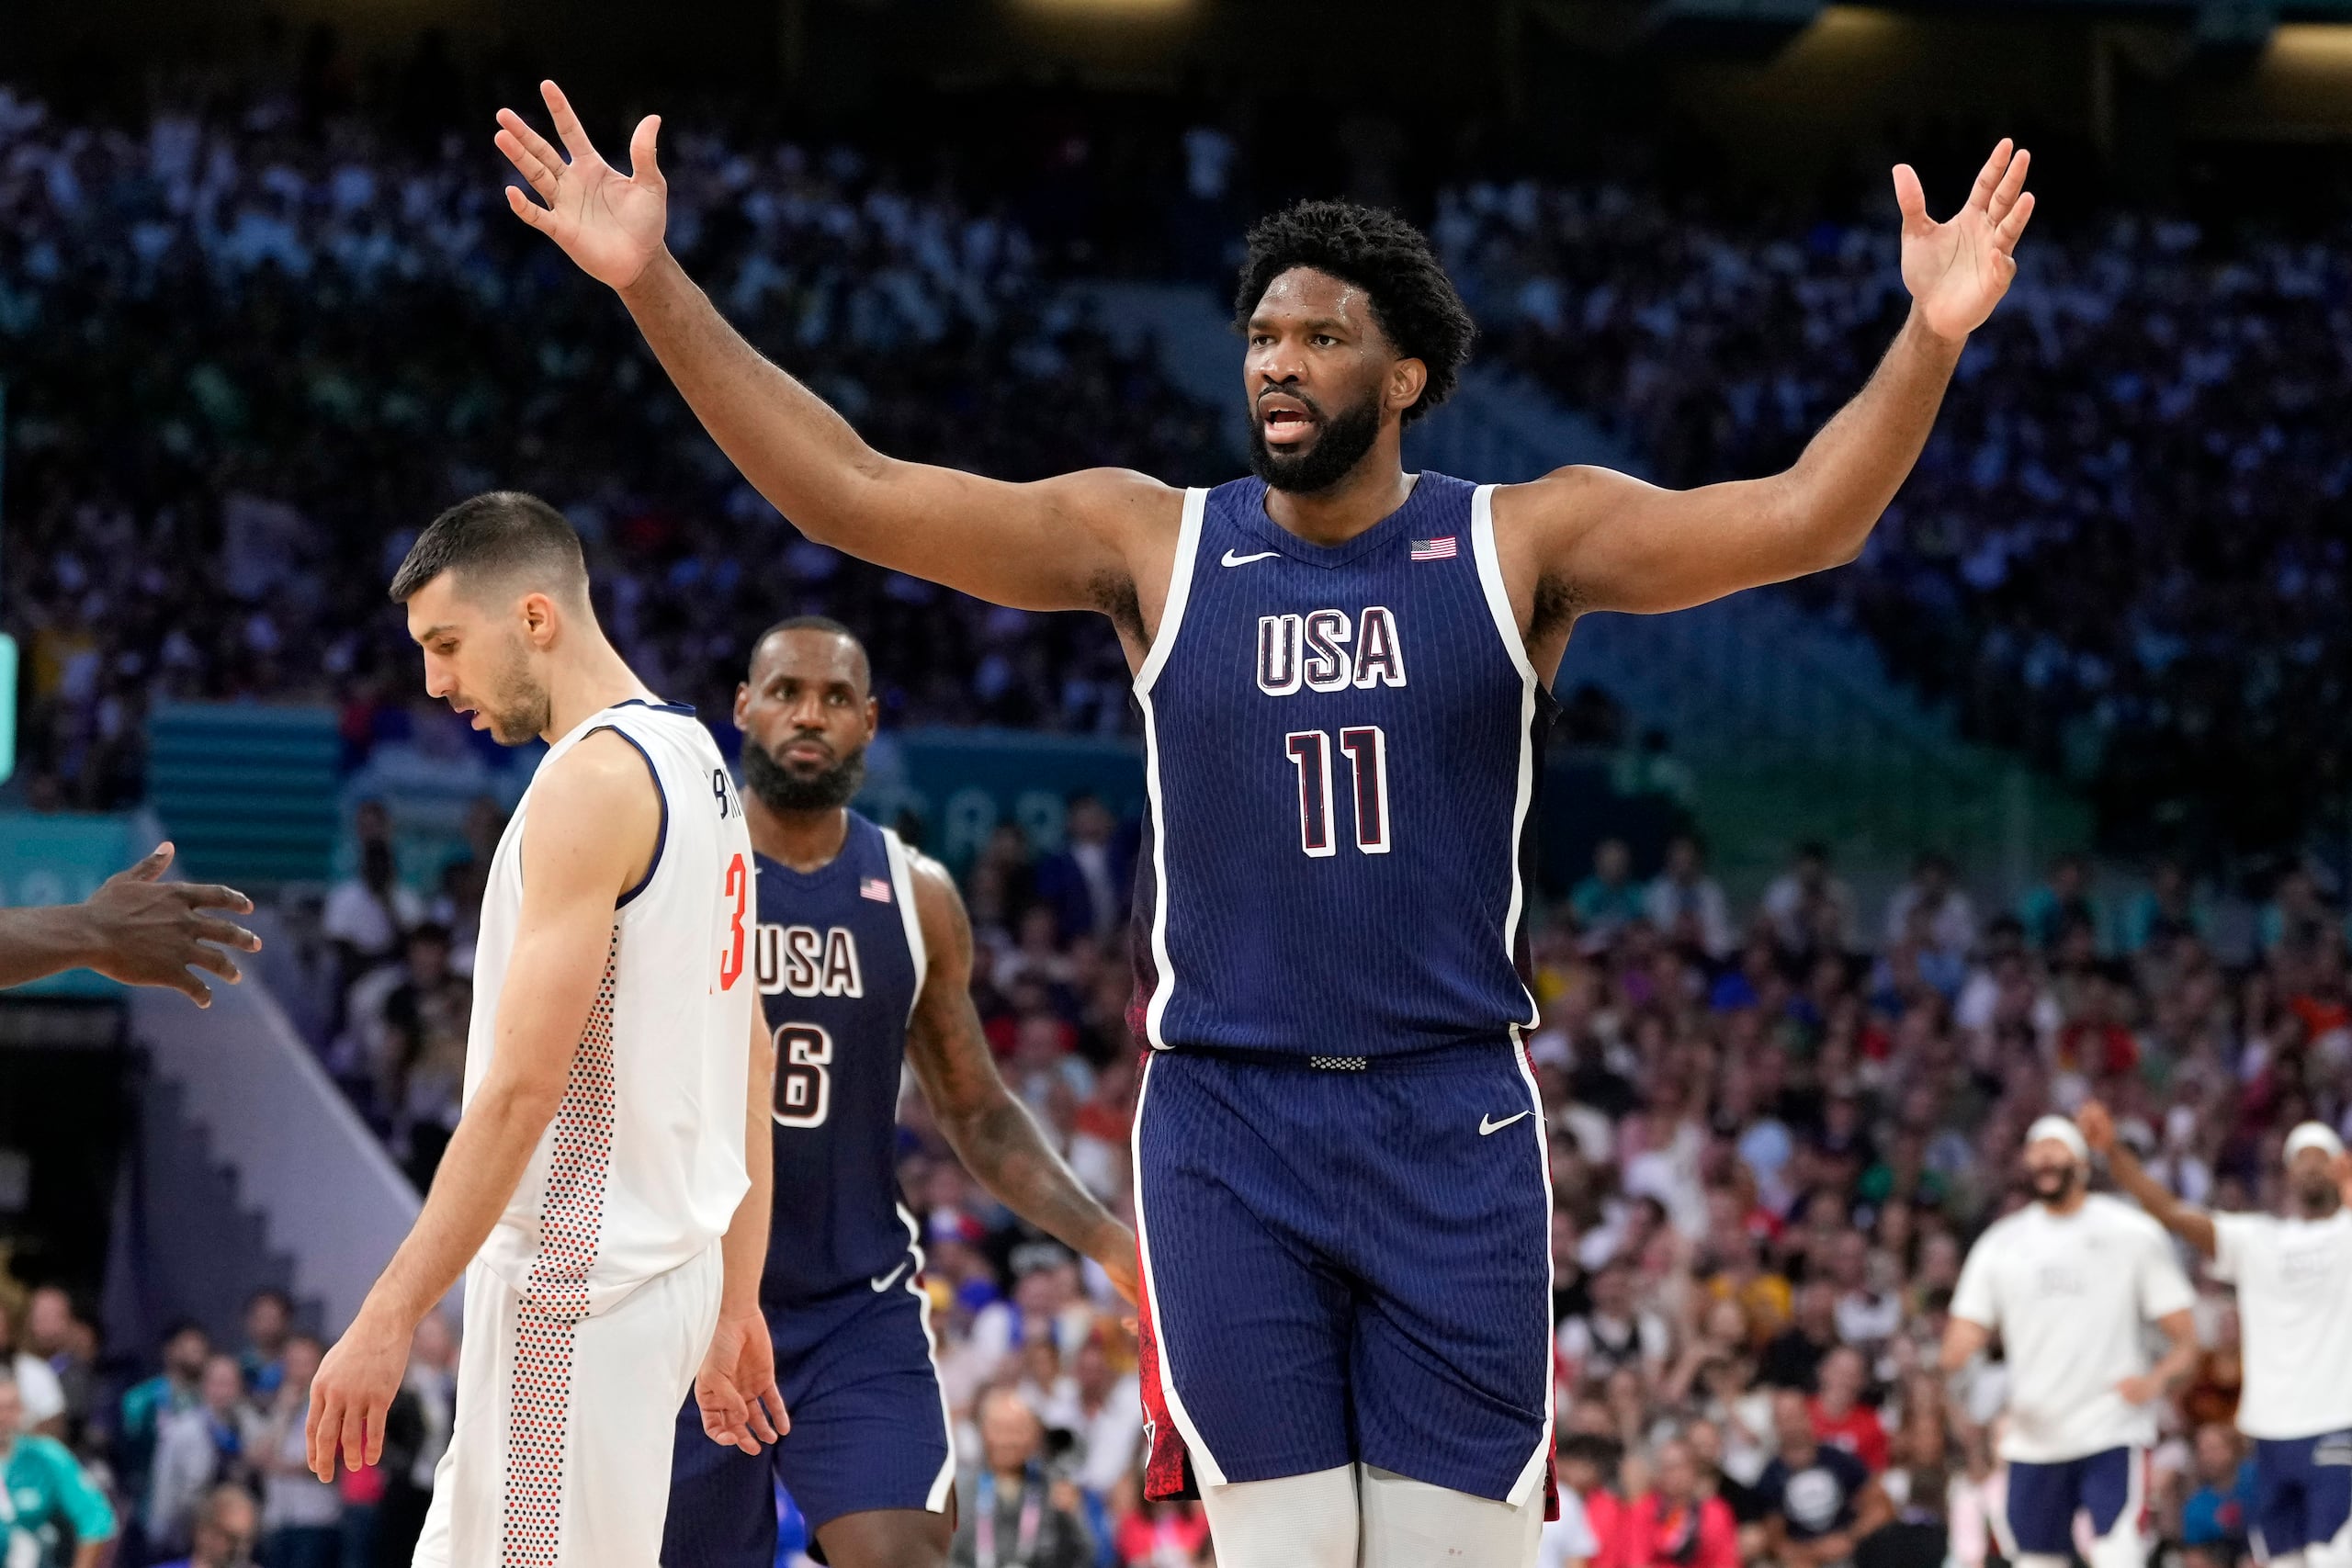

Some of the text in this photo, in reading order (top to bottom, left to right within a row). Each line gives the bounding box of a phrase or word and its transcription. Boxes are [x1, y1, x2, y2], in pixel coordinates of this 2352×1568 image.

[1256, 606, 1408, 696] USA
[1285, 725, 1391, 858] 11
[755, 923, 864, 998] USA
[771, 1021, 832, 1128] 6
